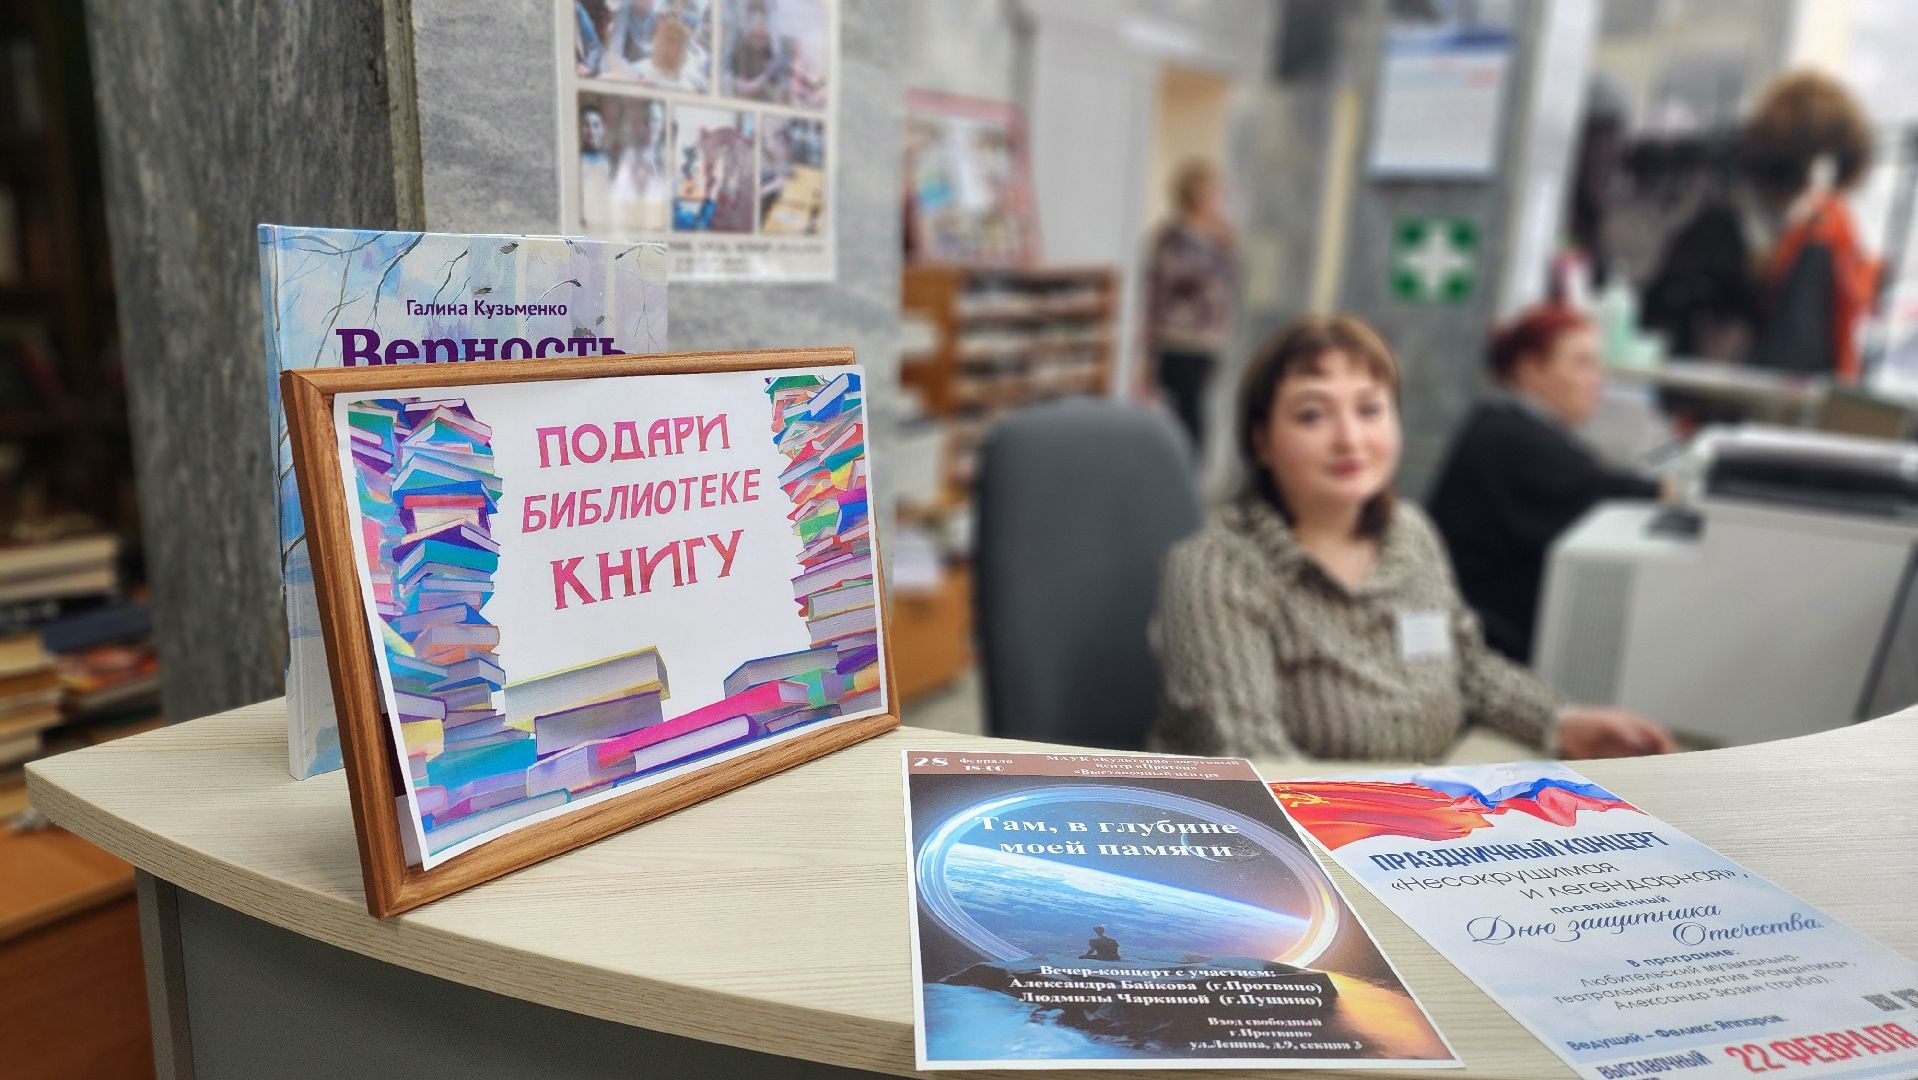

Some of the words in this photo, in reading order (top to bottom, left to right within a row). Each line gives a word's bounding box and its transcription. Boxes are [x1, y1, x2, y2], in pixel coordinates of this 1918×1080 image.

[406, 299, 468, 316] Галина
[474, 299, 568, 318] Кузьменко
[536, 413, 731, 469] ПОДАРИ
[522, 468, 761, 533] БИБЛИОТЕКЕ
[550, 529, 744, 610] КНИГУ
[913, 757, 949, 767] 28
[975, 816, 1058, 834] Там,
[1069, 820, 1088, 832] в
[1100, 819, 1240, 837] глубине
[999, 841, 1088, 856] моей
[1098, 844, 1234, 858] памяти
[1369, 838, 1567, 872] ПРАЗДНИЧНЫЙ
[1557, 830, 1670, 856] КОНЦЕРТ
[1391, 860, 1621, 891] «Несокрушимая
[1519, 887, 1544, 900] и
[1466, 915, 1556, 945] Дню
[1552, 904, 1722, 943] защитника
[1040, 965, 1170, 979] Вечер-концерт
[1176, 969, 1184, 978] с
[1580, 964, 1701, 988] Любительский
[1626, 959, 1640, 968] В
[1008, 977, 1117, 992] Александра
[1120, 979, 1198, 992] Байкова
[1553, 981, 1665, 1005] театральный
[1667, 972, 1749, 991] коллектив
[1614, 989, 1711, 1011] Александр
[1710, 983, 1764, 1000] Зюзин
[1018, 991, 1113, 1005] Людмилы
[1116, 992, 1211, 1006] Чаркиной
[1207, 1017, 1243, 1026] Вход
[1566, 1032, 1644, 1051] Ведущий
[1655, 1021, 1716, 1039] Феликс
[1724, 1044, 1786, 1073] 22
[1768, 1022, 1918, 1065] ФЕВРАЛЯ
[1595, 1050, 1713, 1079] ВЫСТАВОЧНЫЙ
